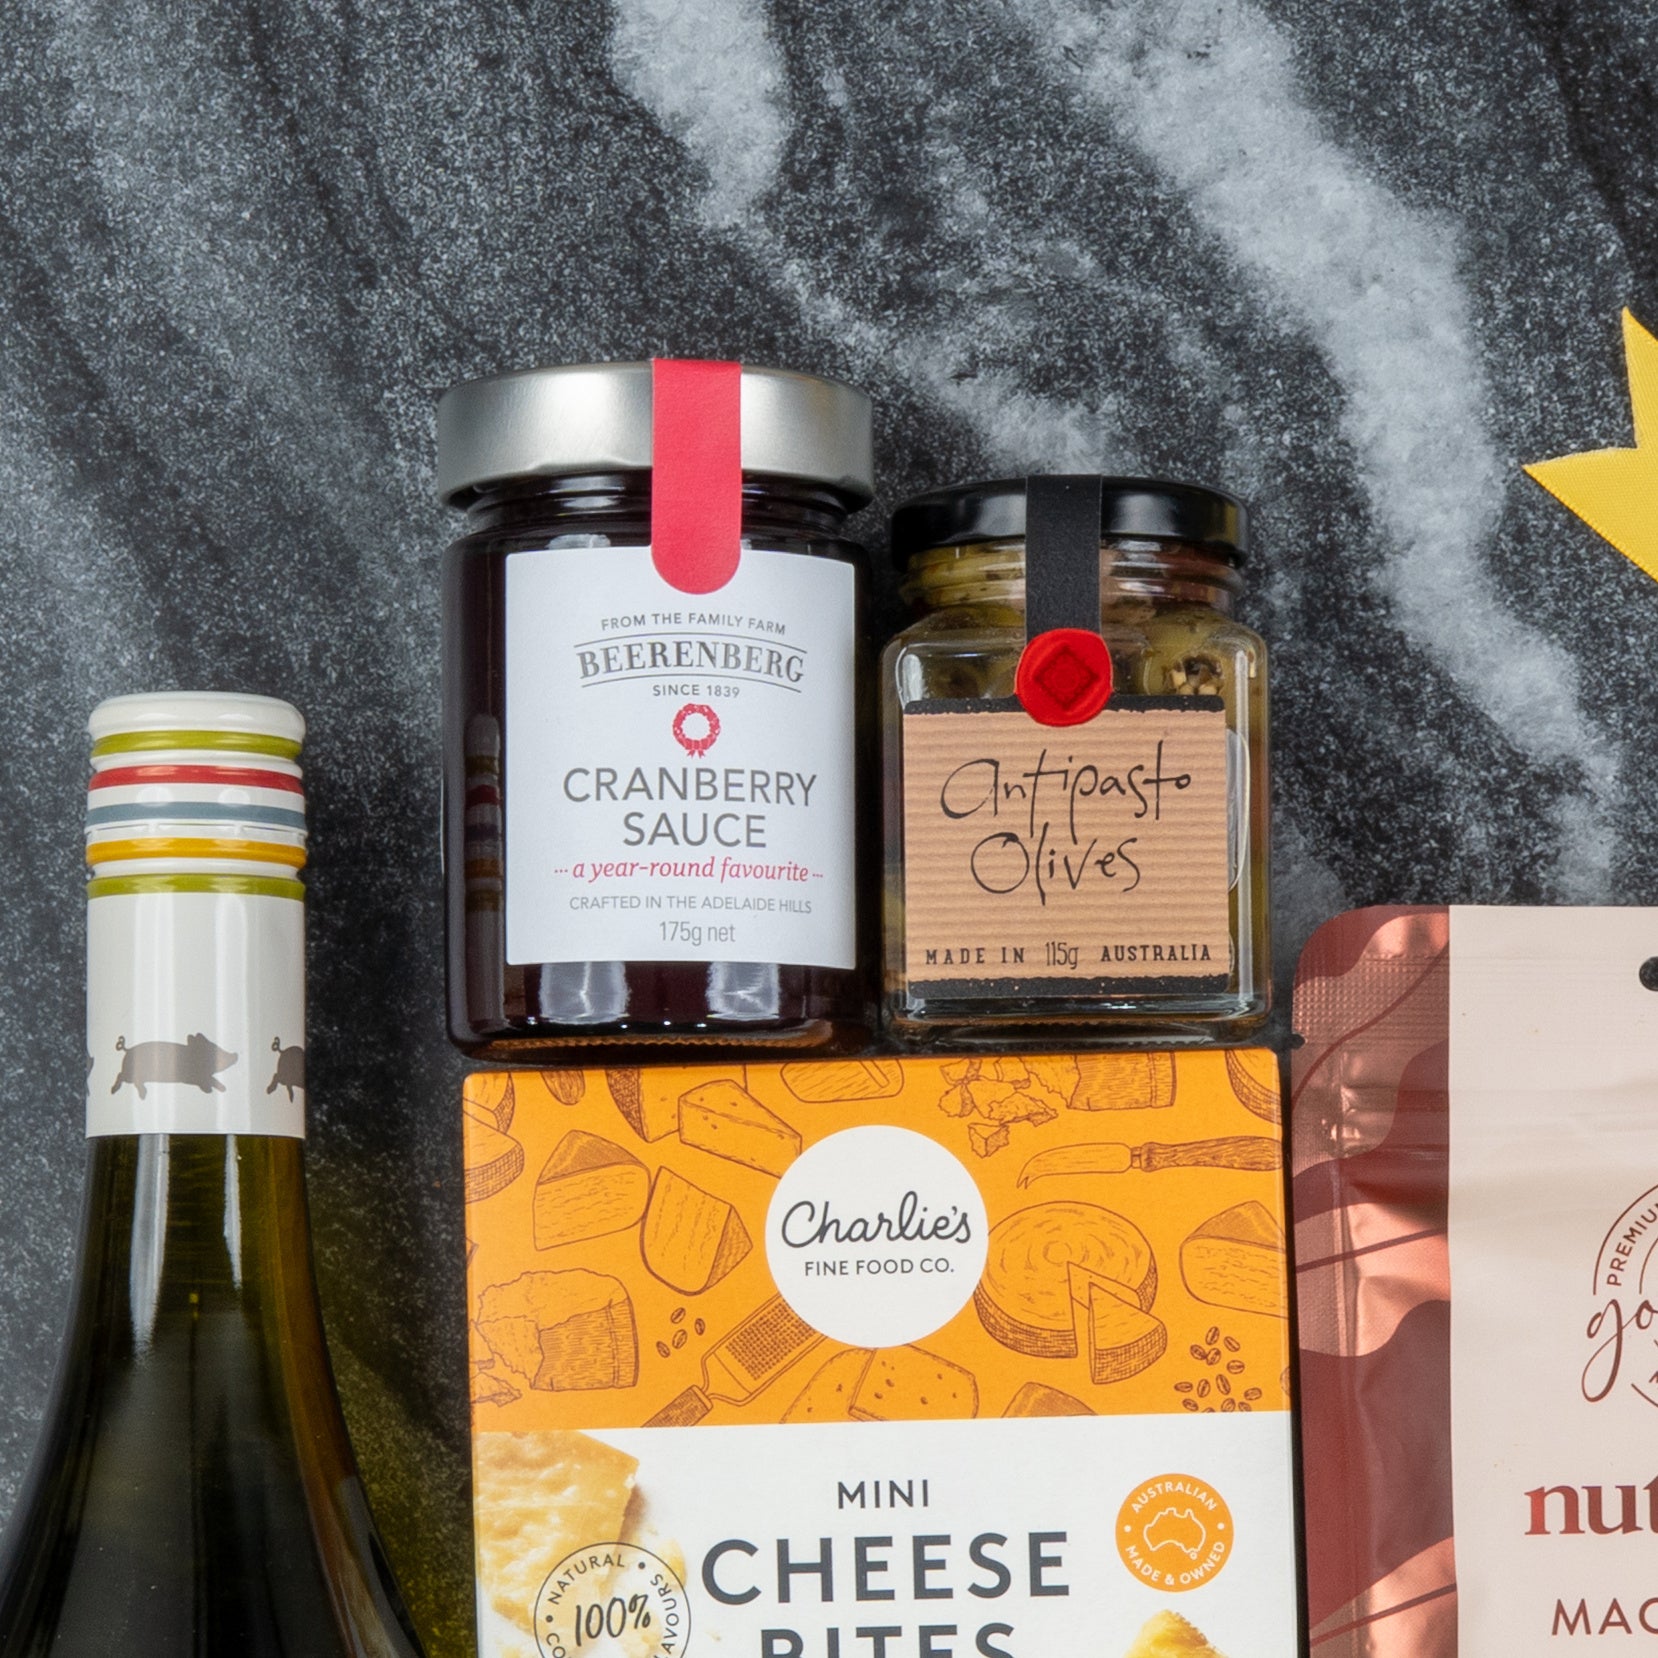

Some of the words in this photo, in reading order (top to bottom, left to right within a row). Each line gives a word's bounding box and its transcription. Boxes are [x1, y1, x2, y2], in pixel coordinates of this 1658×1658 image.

[601, 614, 646, 631] FROM
[651, 612, 682, 625] THE
[688, 612, 743, 627] FAMILY
[747, 617, 786, 636] FARM
[577, 640, 805, 684] BEERENBERG
[652, 683, 700, 697] SINCE
[706, 684, 740, 698] 1839
[563, 766, 818, 807] CRANBERRY
[940, 740, 1192, 845] Antipasto
[623, 811, 767, 849] SAUCE
[572, 862, 585, 879] a
[587, 855, 716, 884] year-round
[720, 857, 809, 884] favourite
[970, 822, 1140, 906] Olives
[569, 895, 641, 911] CRAFTED
[645, 895, 662, 909] IN
[667, 895, 697, 909] THE
[701, 896, 776, 912] ADELAIDE
[779, 899, 812, 915] HILLS
[659, 920, 702, 947] 175g
[707, 924, 736, 943] net
[925, 947, 986, 965] MADE
[1001, 946, 1025, 964] IN
[1045, 941, 1079, 970] 115g
[1100, 943, 1212, 963] AUSTRALIA
[781, 1190, 971, 1249] Charlie's
[1606, 1203, 1658, 1287] PREMIU
[804, 1260, 849, 1277] FINE
[856, 1258, 914, 1275] FOOD
[919, 1257, 955, 1274] CO.
[837, 1479, 929, 1510] MINI
[1131, 1481, 1218, 1513] AUSTRALIAN
[548, 1553, 626, 1606] NATURAL
[701, 1531, 1070, 1606] CHEESE
[1125, 1544, 1161, 1582] MADE
[1164, 1574, 1175, 1586] &
[1179, 1541, 1226, 1585] OWNED
[575, 1593, 651, 1647] 100%
[649, 1573, 681, 1658] AVOURS
